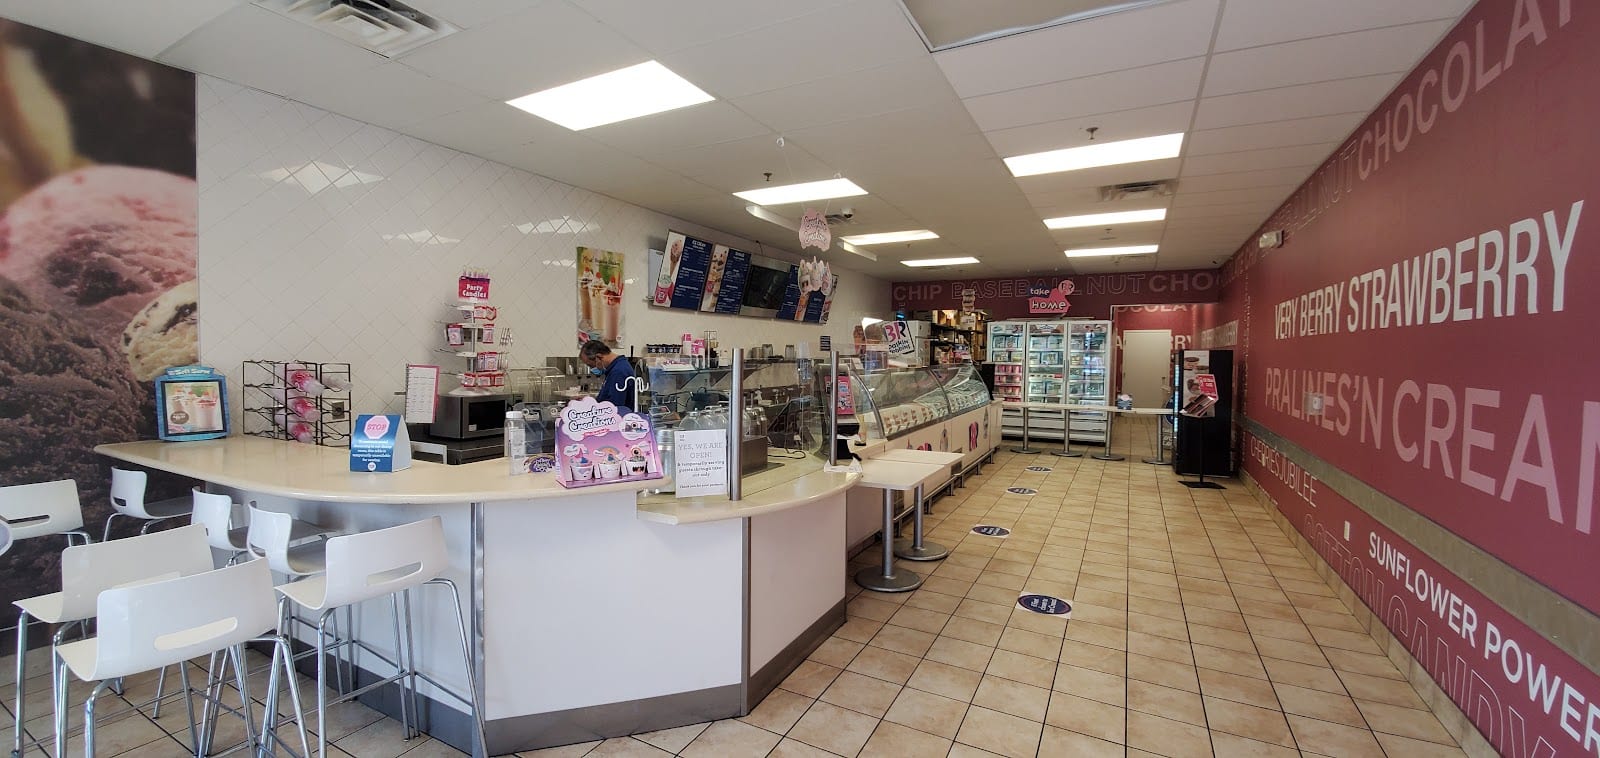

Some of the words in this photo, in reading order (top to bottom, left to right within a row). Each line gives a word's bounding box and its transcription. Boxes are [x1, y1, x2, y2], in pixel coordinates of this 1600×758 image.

[1275, 297, 1299, 340] VERY
[1300, 281, 1345, 337] BERRY
[1347, 199, 1584, 333] STRAWBERRY
[462, 289, 487, 298] Candles
[466, 283, 483, 292] Party
[893, 284, 942, 301] CHIP
[1087, 274, 1145, 295] NUT
[1149, 272, 1219, 293] CHO
[568, 406, 612, 420] Creature
[569, 417, 616, 432] Creations
[678, 443, 694, 451] YES,
[690, 451, 712, 459] OPEN!
[1280, 453, 1318, 508] JUBILEE
[1369, 531, 1476, 648] SUNFLOWER
[1484, 621, 1600, 758] POWER
